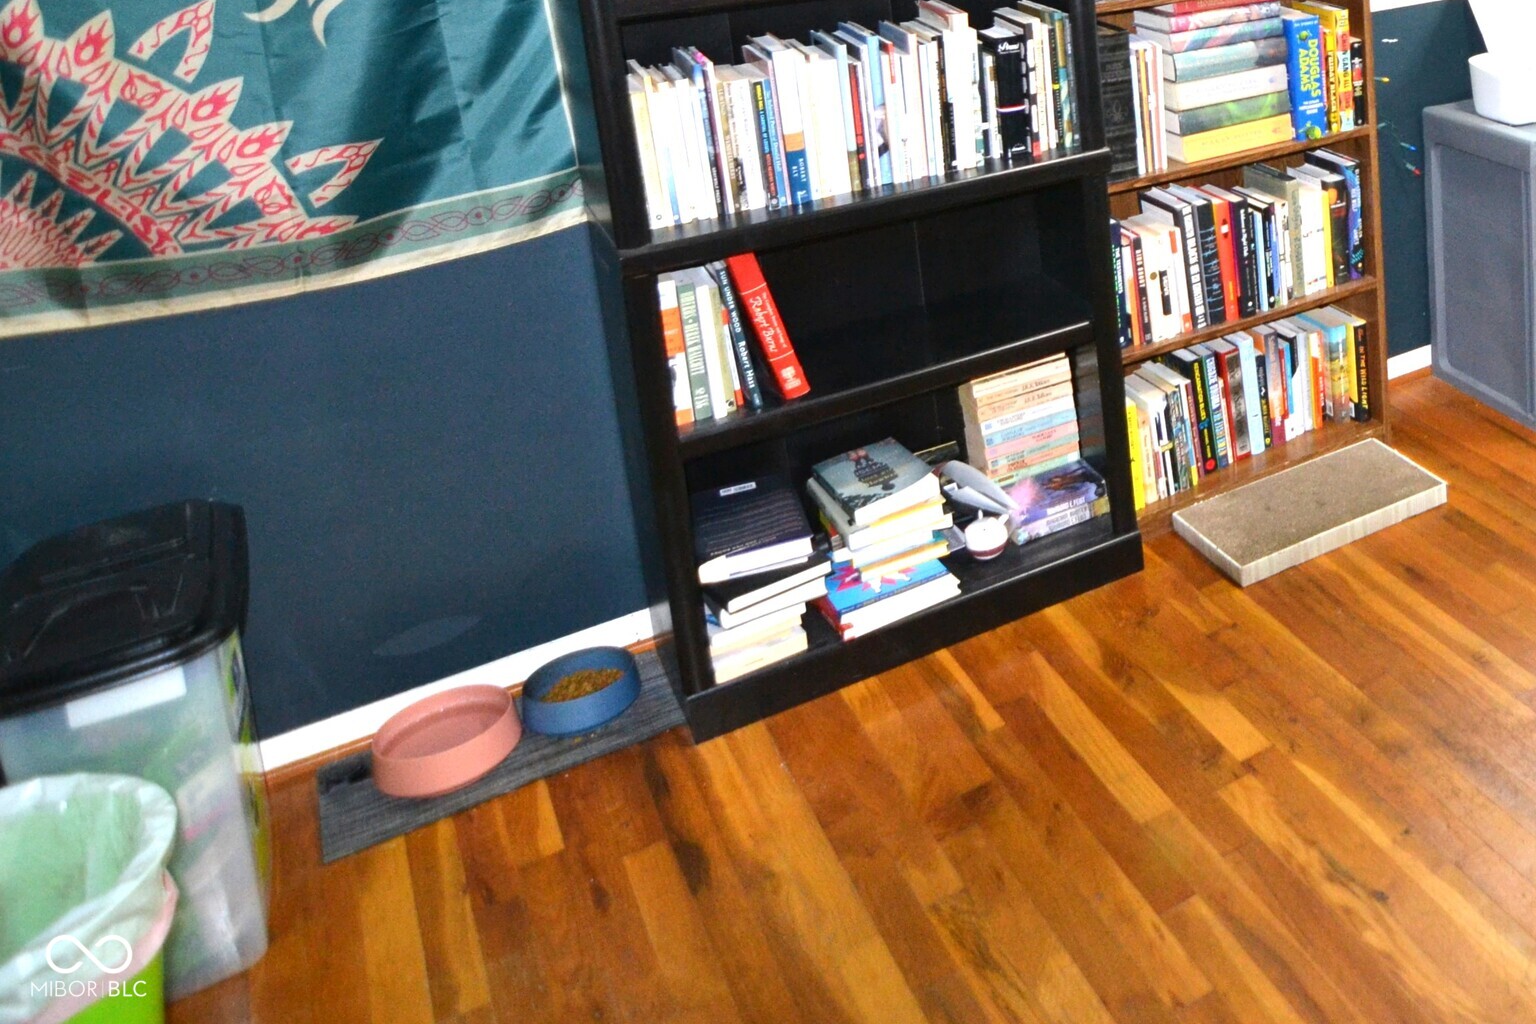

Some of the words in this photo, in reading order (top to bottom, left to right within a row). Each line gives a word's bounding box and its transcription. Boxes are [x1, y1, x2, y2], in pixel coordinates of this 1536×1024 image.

[1298, 48, 1311, 92] ADAMS
[1308, 39, 1321, 97] DOUGLAS
[719, 271, 728, 285] SUN
[1115, 259, 1123, 294] TESTAMENTS
[723, 286, 736, 309] UNDER
[686, 323, 699, 345] DEREK
[730, 310, 742, 333] WOOD
[748, 294, 771, 329] Robert
[761, 327, 779, 354] Burns
[688, 345, 704, 376] WALCOTT
[737, 341, 752, 368] Robert
[745, 369, 757, 388] Hass
[1194, 363, 1203, 402] REINCARNATION
[1361, 386, 1369, 409] LIGHT
